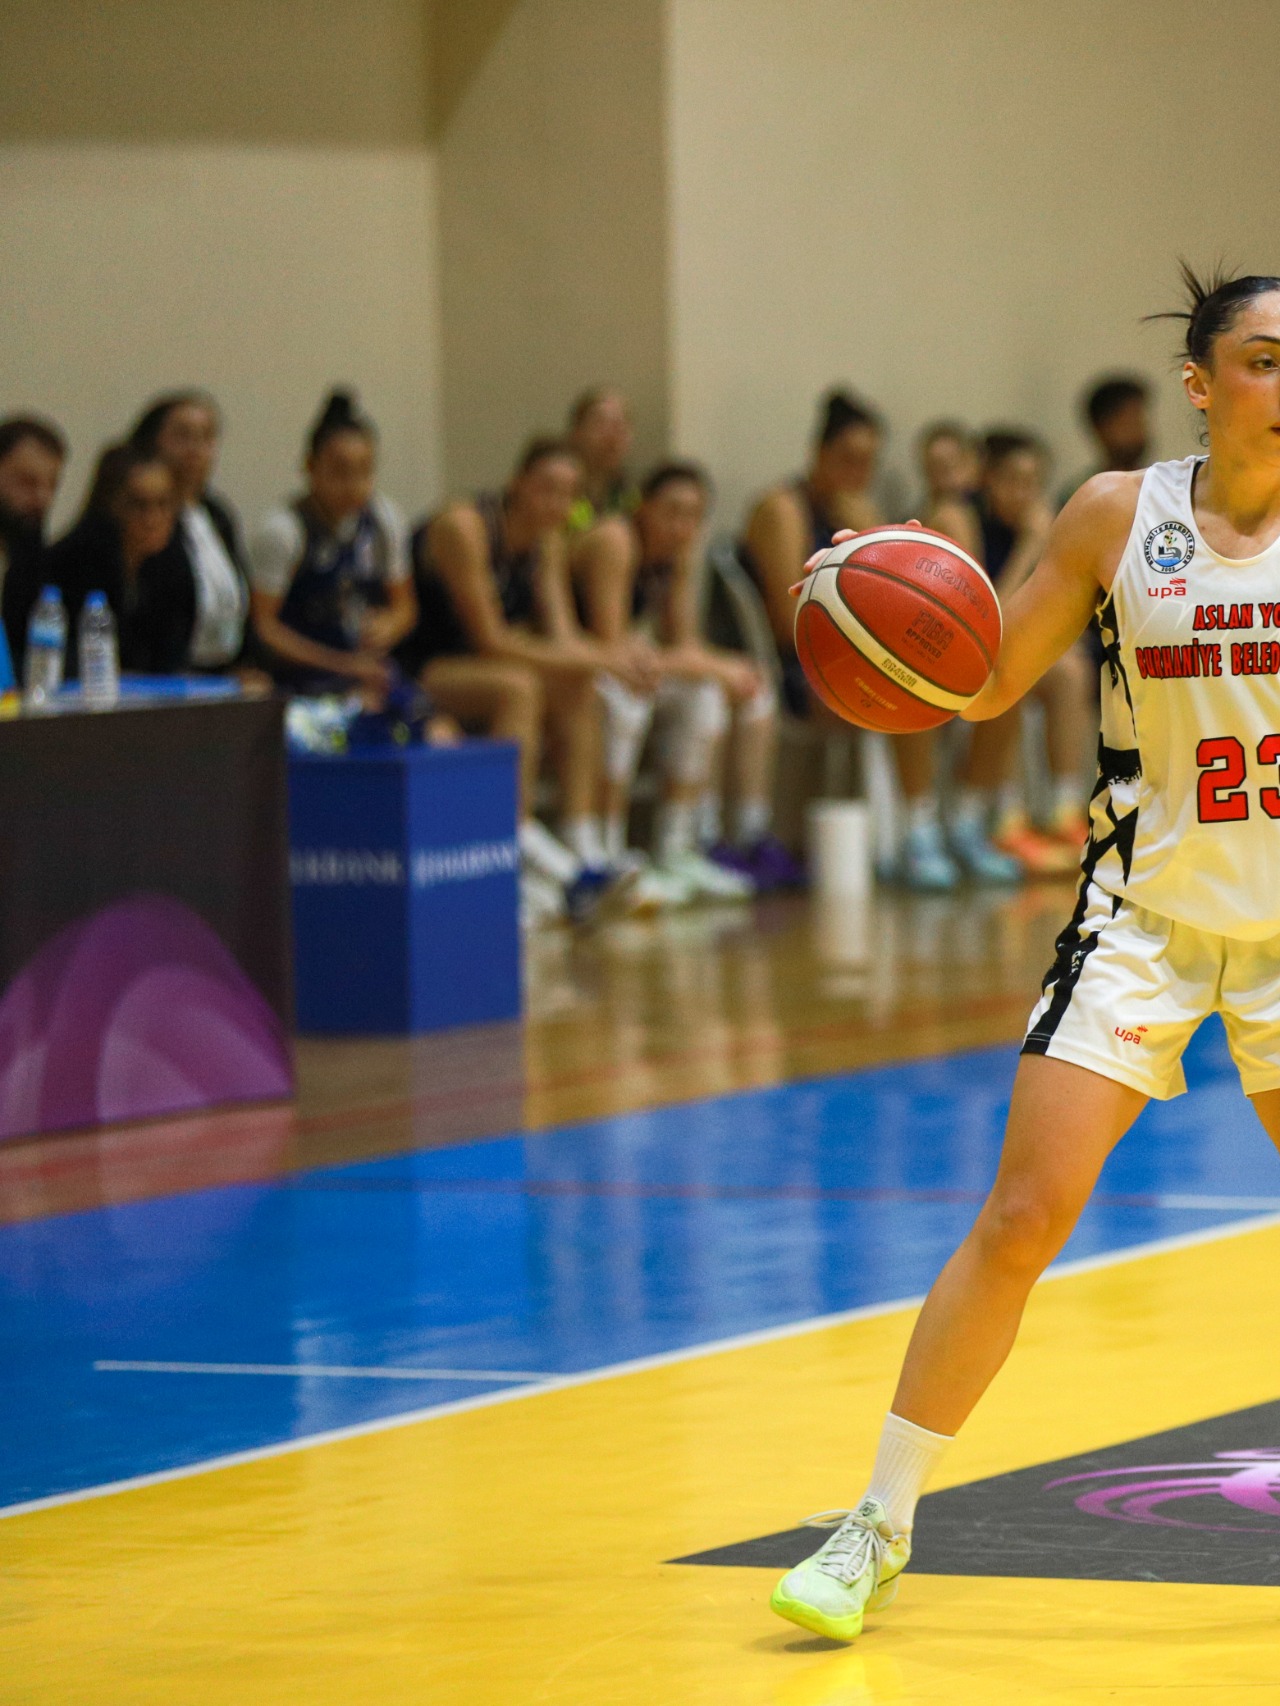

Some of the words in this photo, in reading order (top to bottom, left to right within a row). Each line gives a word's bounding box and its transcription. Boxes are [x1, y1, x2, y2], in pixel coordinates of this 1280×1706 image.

[1147, 586, 1187, 599] upa
[911, 609, 955, 651] FIBA
[1192, 603, 1254, 631] ASLAN
[1135, 638, 1223, 680] BURHANİYE
[1114, 1026, 1142, 1045] upa
